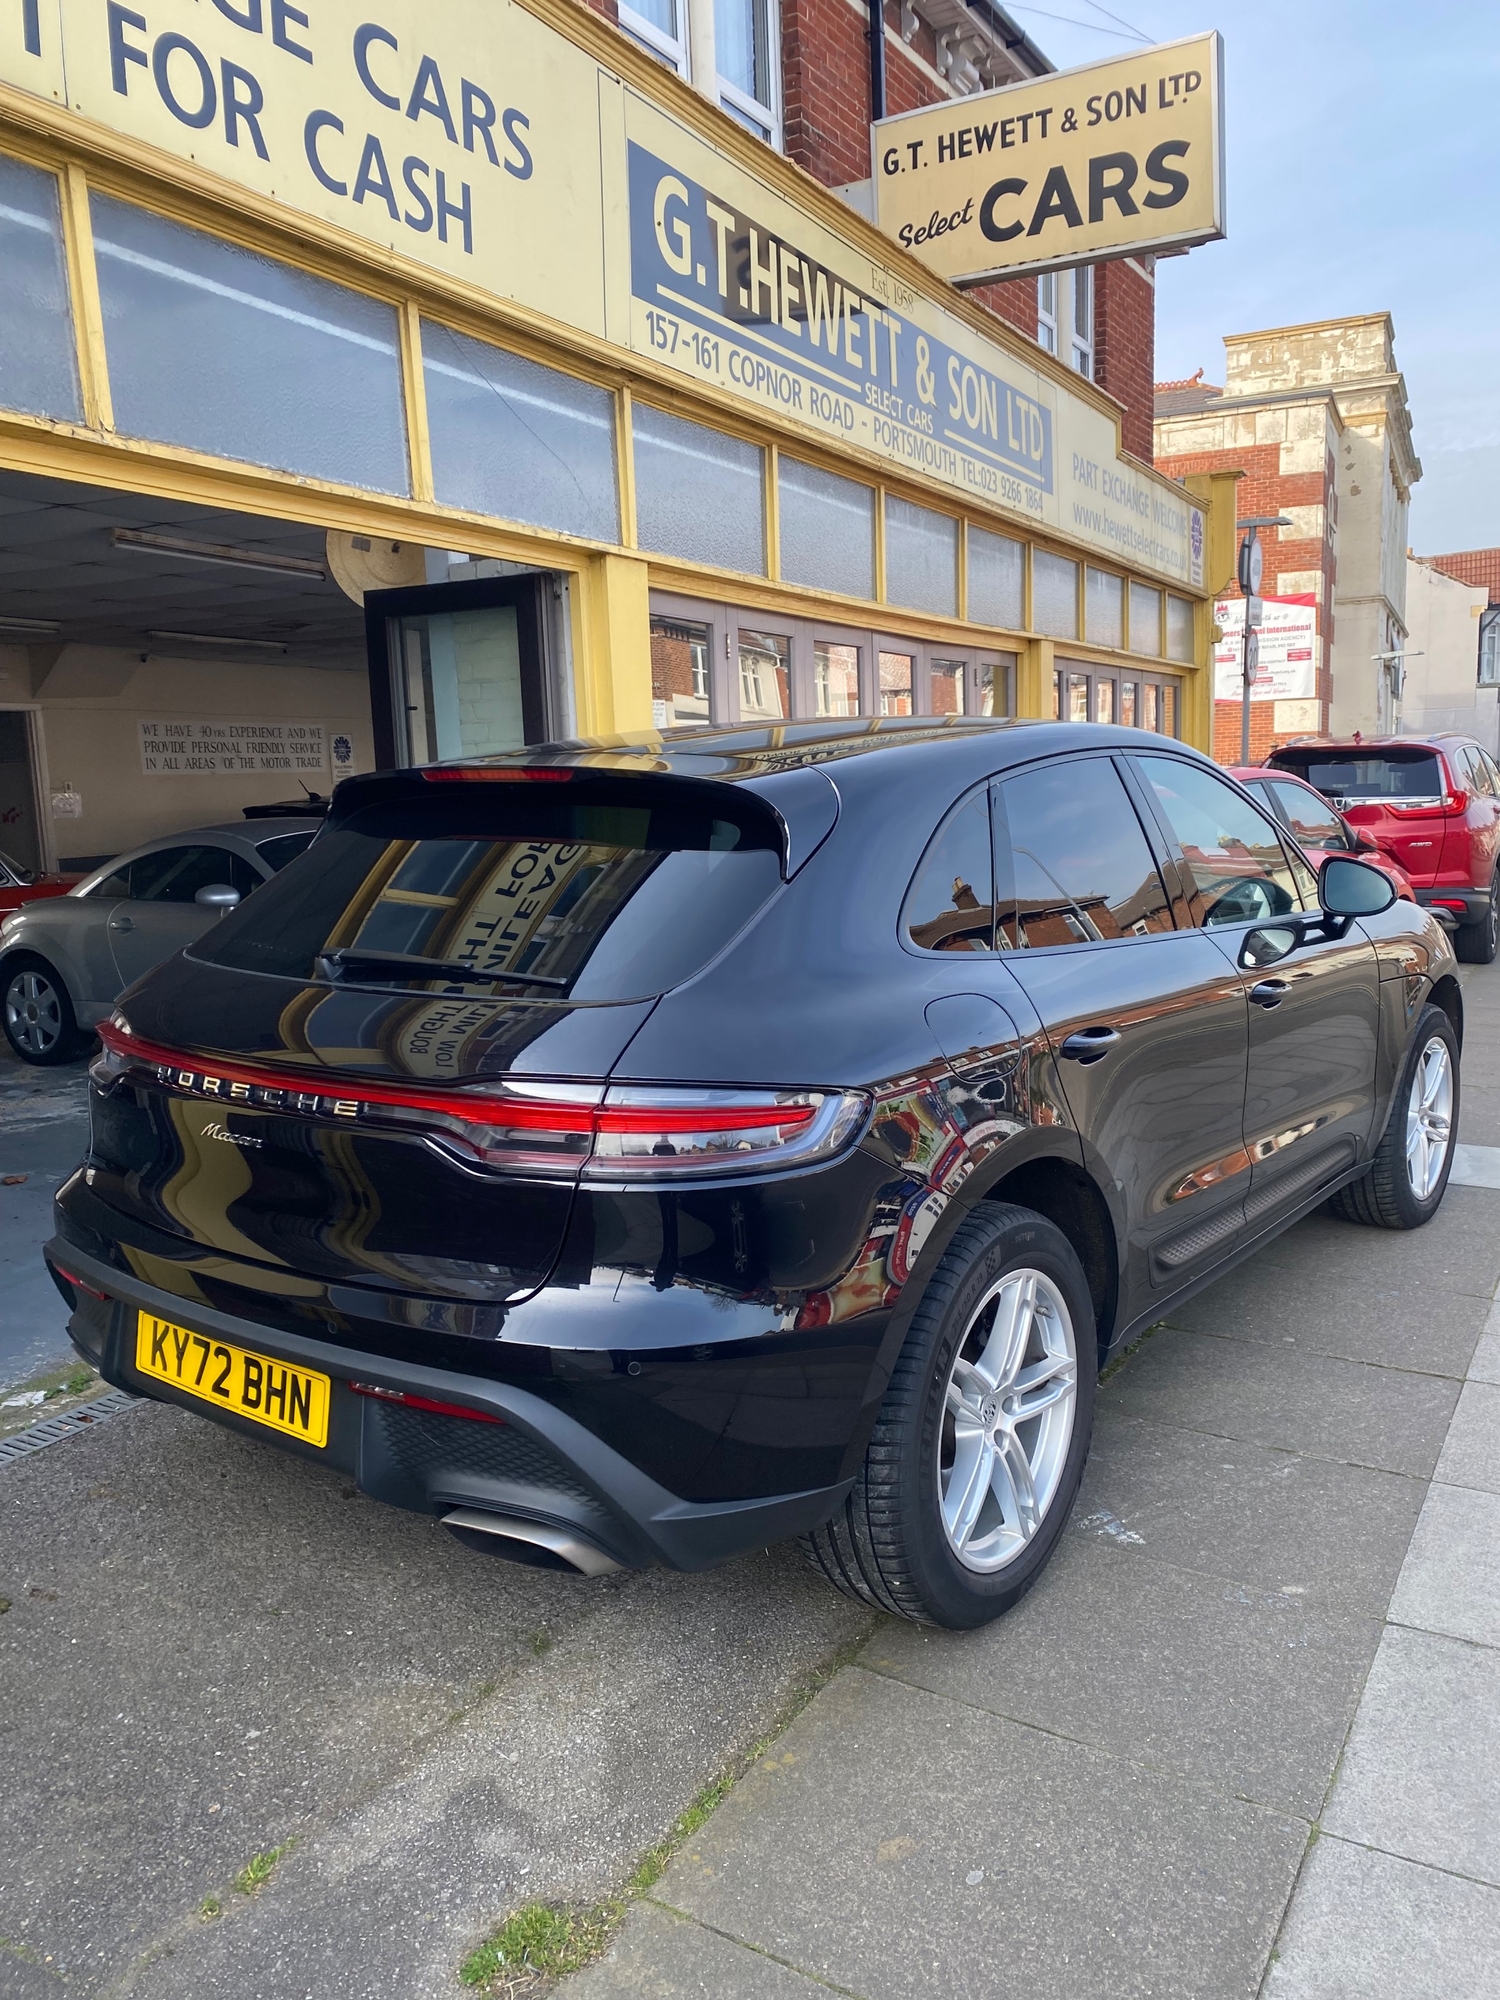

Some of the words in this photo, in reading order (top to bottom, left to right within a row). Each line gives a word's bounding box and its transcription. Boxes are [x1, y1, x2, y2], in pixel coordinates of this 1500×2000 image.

[108, 0, 271, 162] FOR
[303, 109, 474, 256] CASH
[352, 22, 534, 181] CARS
[883, 139, 928, 176] G.T.
[938, 107, 1054, 164] HEWETT
[1060, 107, 1079, 133] &
[1086, 83, 1147, 127] SON
[899, 197, 975, 248] Select
[979, 139, 1191, 243] CARS
[893, 282, 914, 314] 1958
[645, 309, 720, 374] 157-161
[728, 349, 802, 410] COPNOR
[809, 385, 855, 431] ROAD
[873, 415, 957, 477] PORTSMOUTH
[1001, 475, 1022, 504] 9266
[1025, 486, 1043, 513] 1864
[865, 382, 903, 420] SELECT
[906, 404, 934, 434] CARS
[915, 335, 937, 408] &
[947, 355, 998, 441] SON
[1006, 390, 1044, 462] LTD
[1073, 452, 1098, 491] PART
[1102, 468, 1150, 519] EXCHANGE
[1152, 497, 1187, 539] WELCOME
[1267, 623, 1312, 634] International
[142, 724, 158, 737] WE
[165, 724, 192, 737] HAVE
[230, 726, 283, 739] EXPERIENCE
[287, 727, 306, 739] AND
[309, 727, 322, 739] WE
[144, 741, 186, 753] PROVIDE
[192, 741, 242, 754] PERSONAL
[247, 742, 286, 754] FRIENDLY
[290, 742, 322, 754] SERVICE
[146, 757, 157, 770] IN
[162, 757, 180, 770] ALL
[185, 757, 216, 770] AREAS
[224, 757, 235, 769] OF
[239, 757, 255, 769] THE
[261, 757, 291, 769] MOTOR
[296, 757, 323, 768] TRADE
[157, 1067, 358, 1116] PORSCHE
[200, 1122, 263, 1148] Macan
[151, 1320, 232, 1401] KY72
[241, 1356, 312, 1431] BHN
